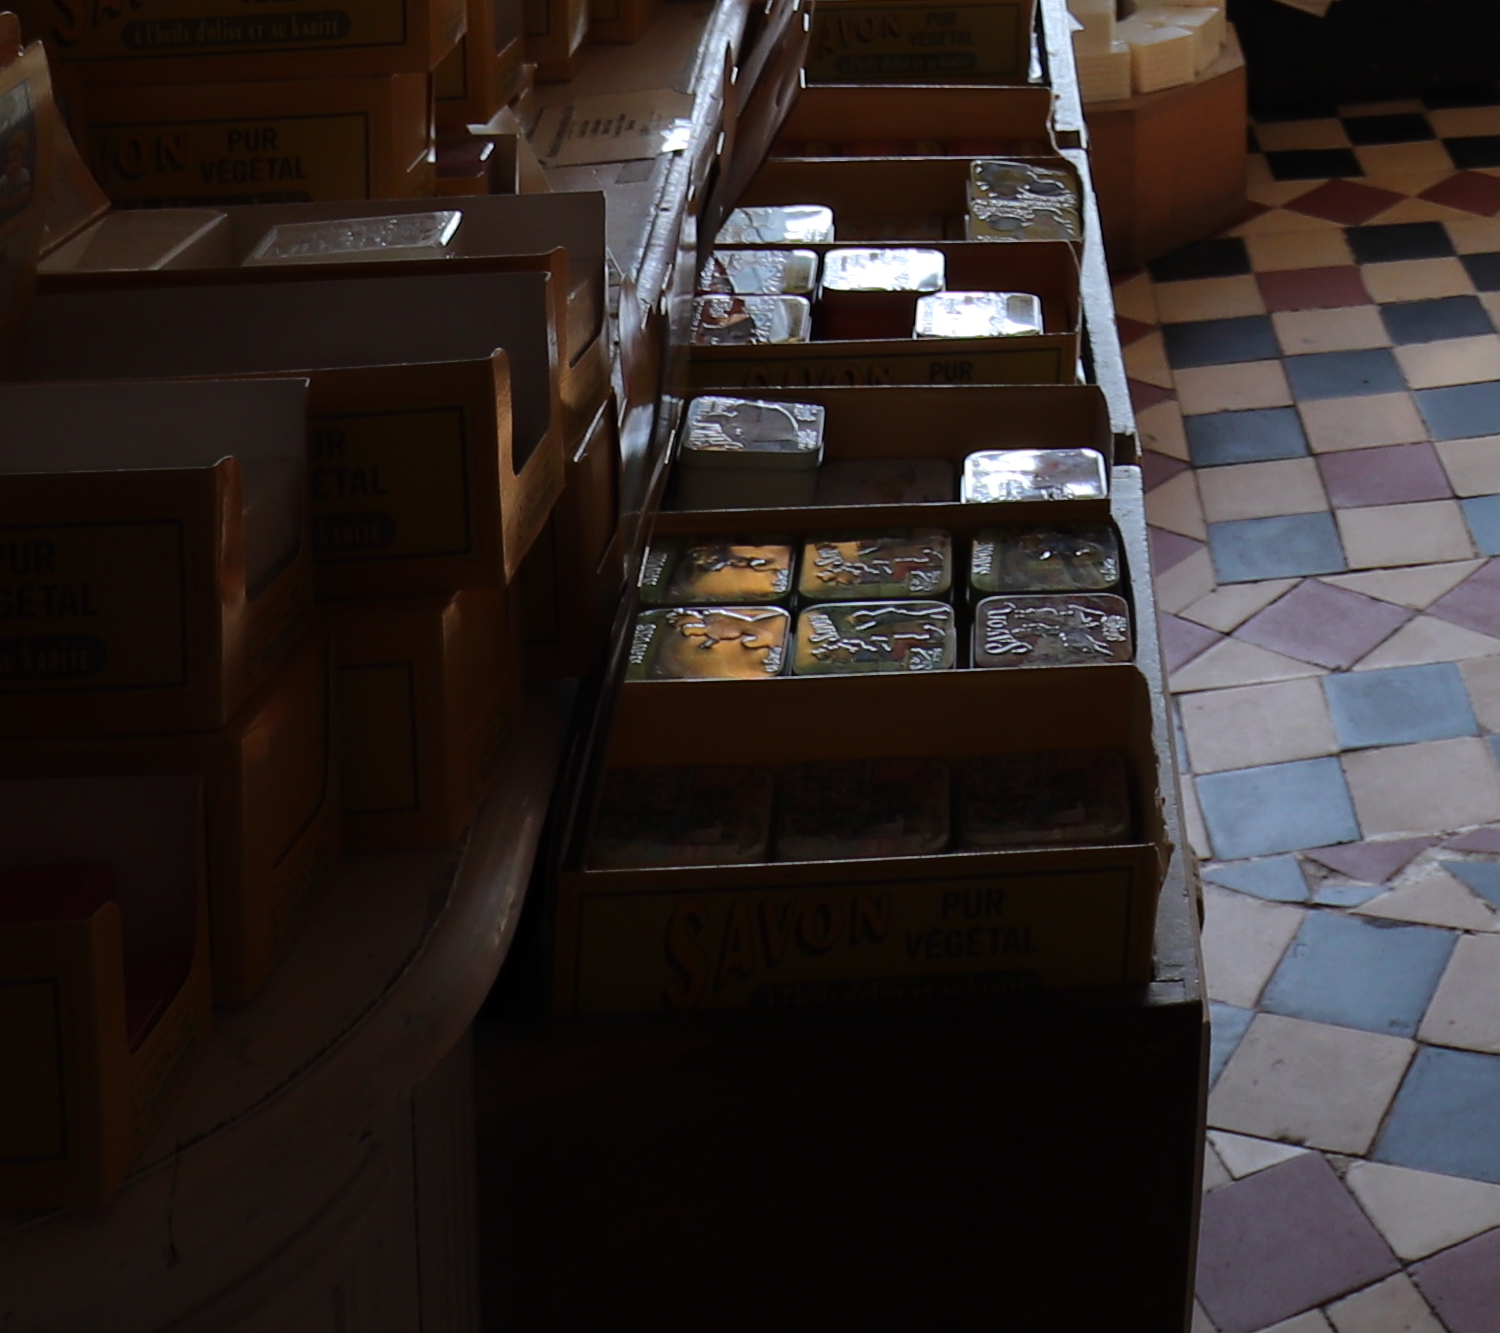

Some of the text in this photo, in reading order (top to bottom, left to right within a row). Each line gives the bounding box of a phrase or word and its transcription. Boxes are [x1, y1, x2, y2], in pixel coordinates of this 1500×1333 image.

[225, 126, 279, 155] PUR
[199, 155, 309, 186] VÉGÉTAL
[311, 465, 388, 499] ÉTAL
[941, 888, 1004, 920] PUR
[663, 893, 892, 1013] SAVON
[905, 924, 1040, 961] VÉGÉTAL
